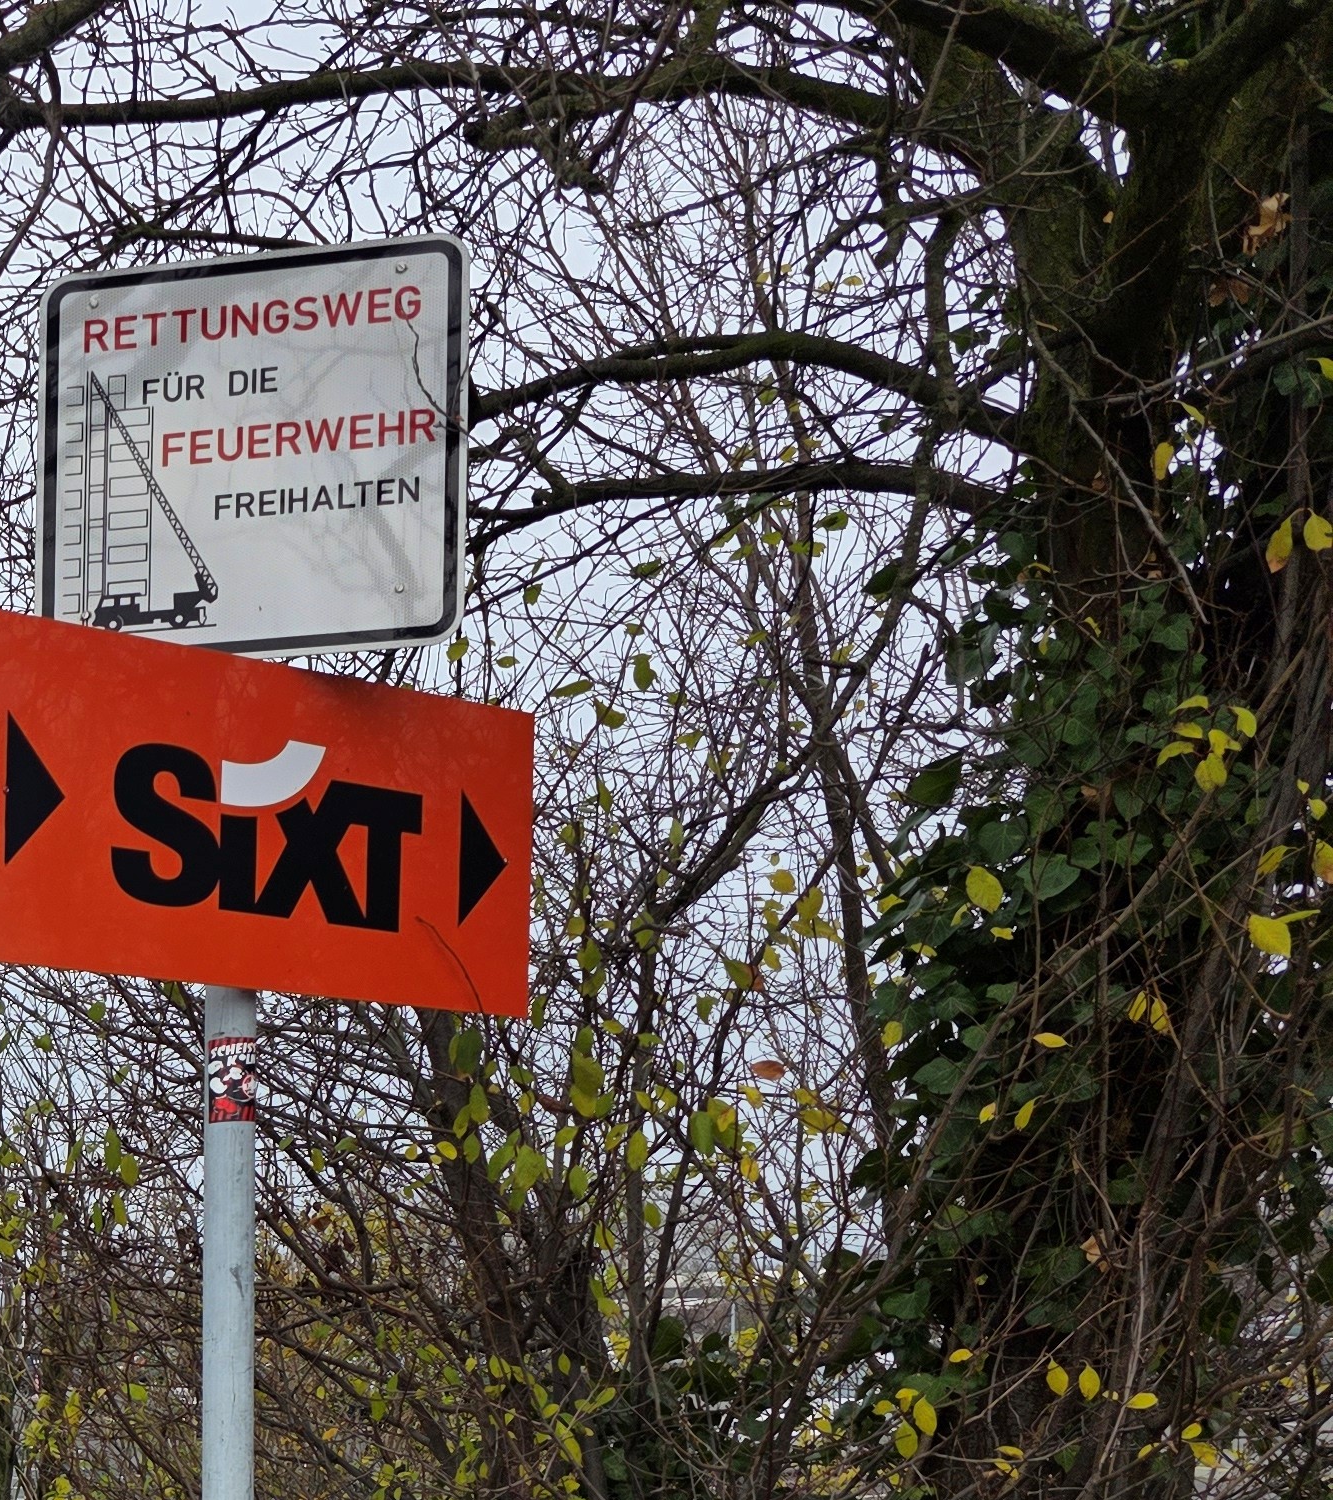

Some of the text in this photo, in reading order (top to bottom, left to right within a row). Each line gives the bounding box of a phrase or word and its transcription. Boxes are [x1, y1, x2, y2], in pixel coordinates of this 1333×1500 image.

[83, 285, 422, 353] RETTUNGSWEG
[141, 366, 279, 405] FÜR DIE
[161, 408, 436, 468] FEUERWEHR
[213, 476, 421, 521] FREIHALTEN
